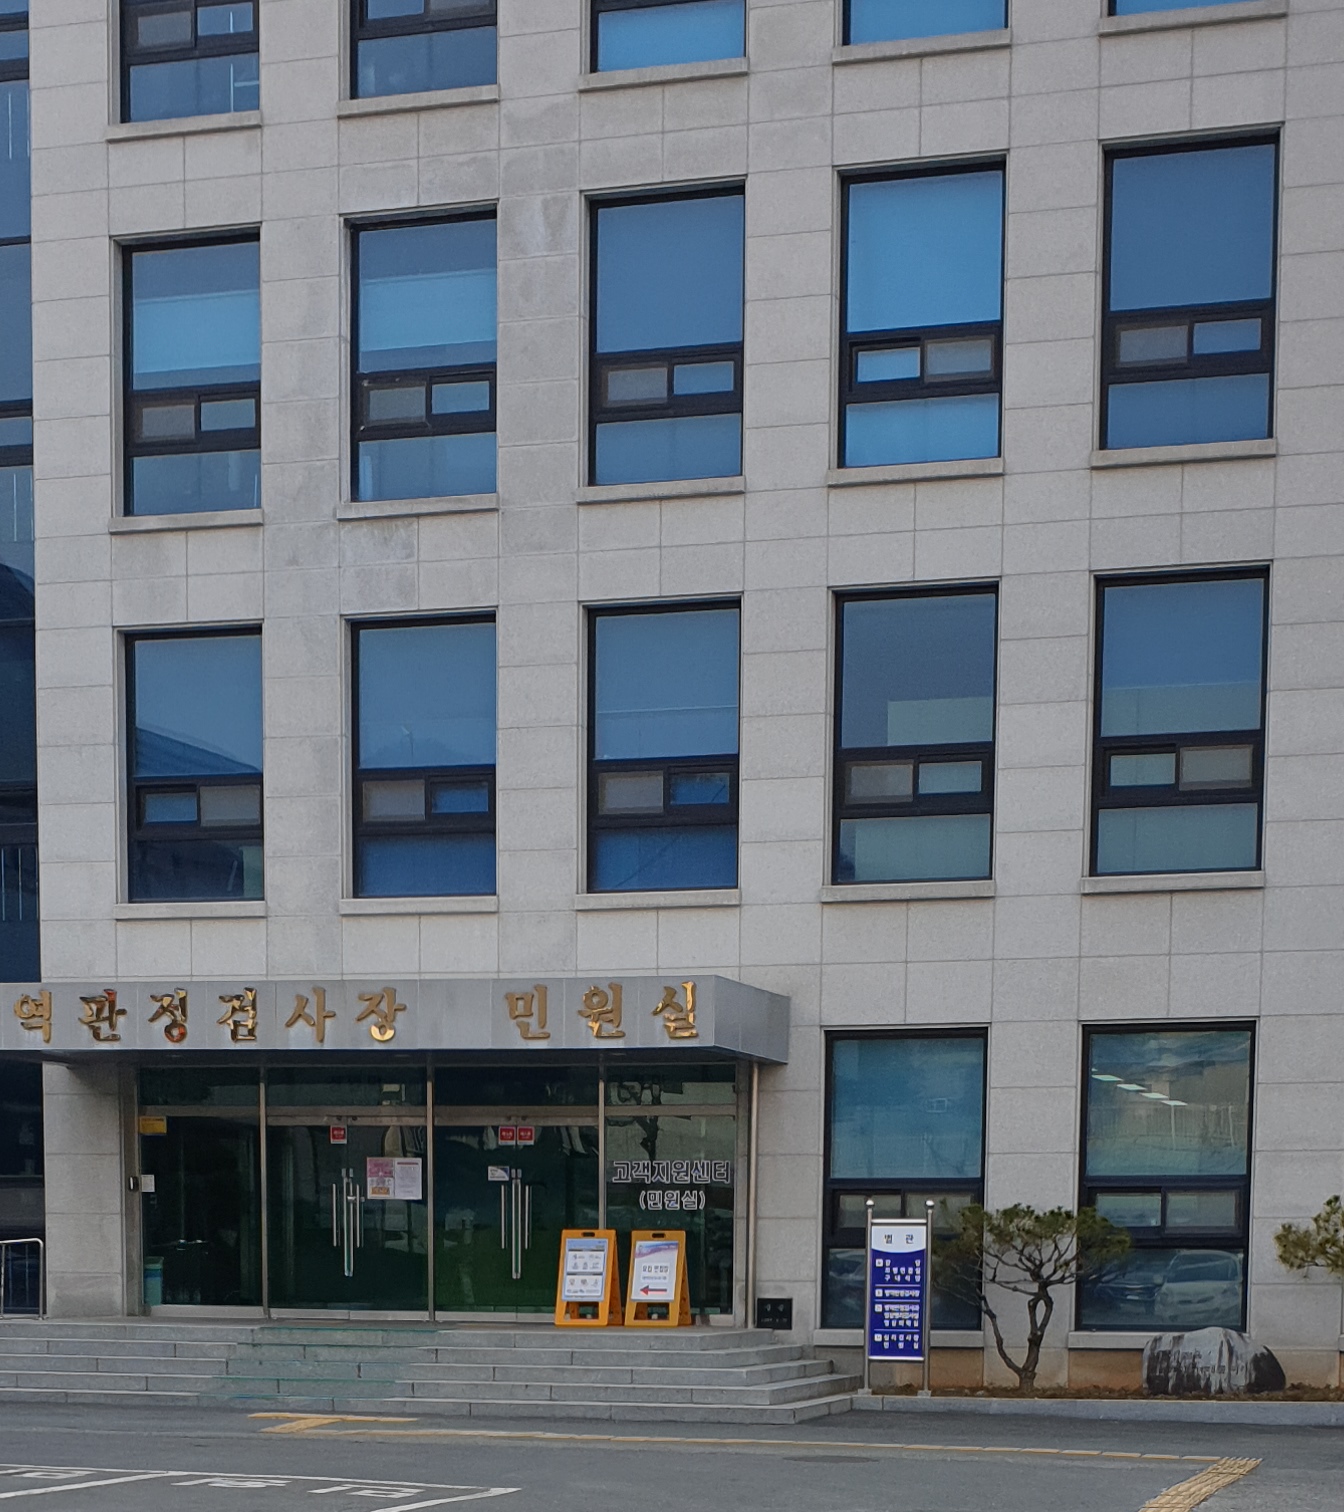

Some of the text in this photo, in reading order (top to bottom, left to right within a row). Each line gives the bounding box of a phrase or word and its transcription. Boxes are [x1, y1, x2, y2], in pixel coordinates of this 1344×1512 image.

[503, 979, 700, 1040] 민원실
[612, 1160, 731, 1184] 고객지원센터
[638, 1190, 706, 1210] (민원실)
